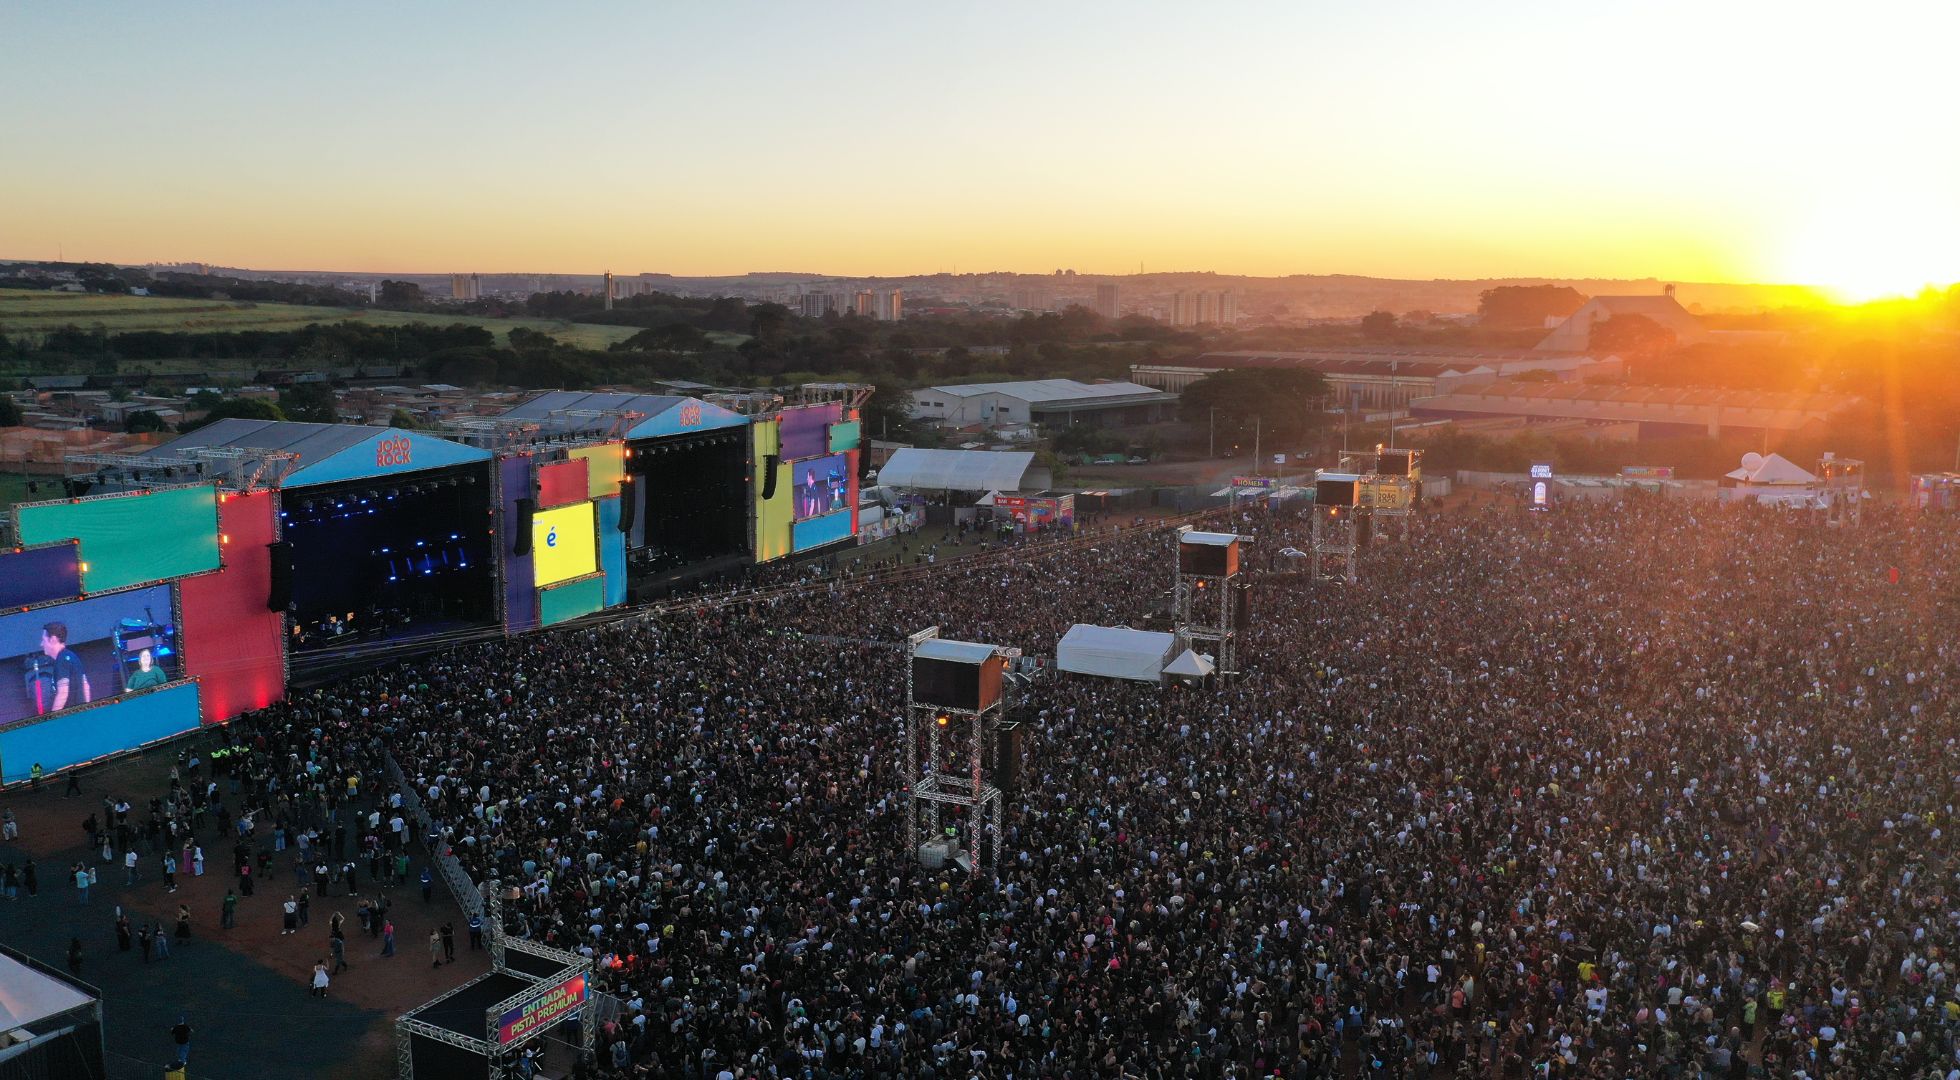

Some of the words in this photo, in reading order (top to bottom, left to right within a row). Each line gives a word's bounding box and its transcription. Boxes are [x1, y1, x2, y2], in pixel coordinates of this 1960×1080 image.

[680, 415, 701, 427] ROCK
[377, 434, 411, 453] JOÃO
[376, 451, 411, 467] ROCK
[1237, 479, 1264, 487] HOMEM
[546, 526, 557, 548] é
[522, 986, 567, 1018] ENTRADA
[511, 1014, 536, 1036] PISTA
[537, 991, 578, 1021] PREMIUM
